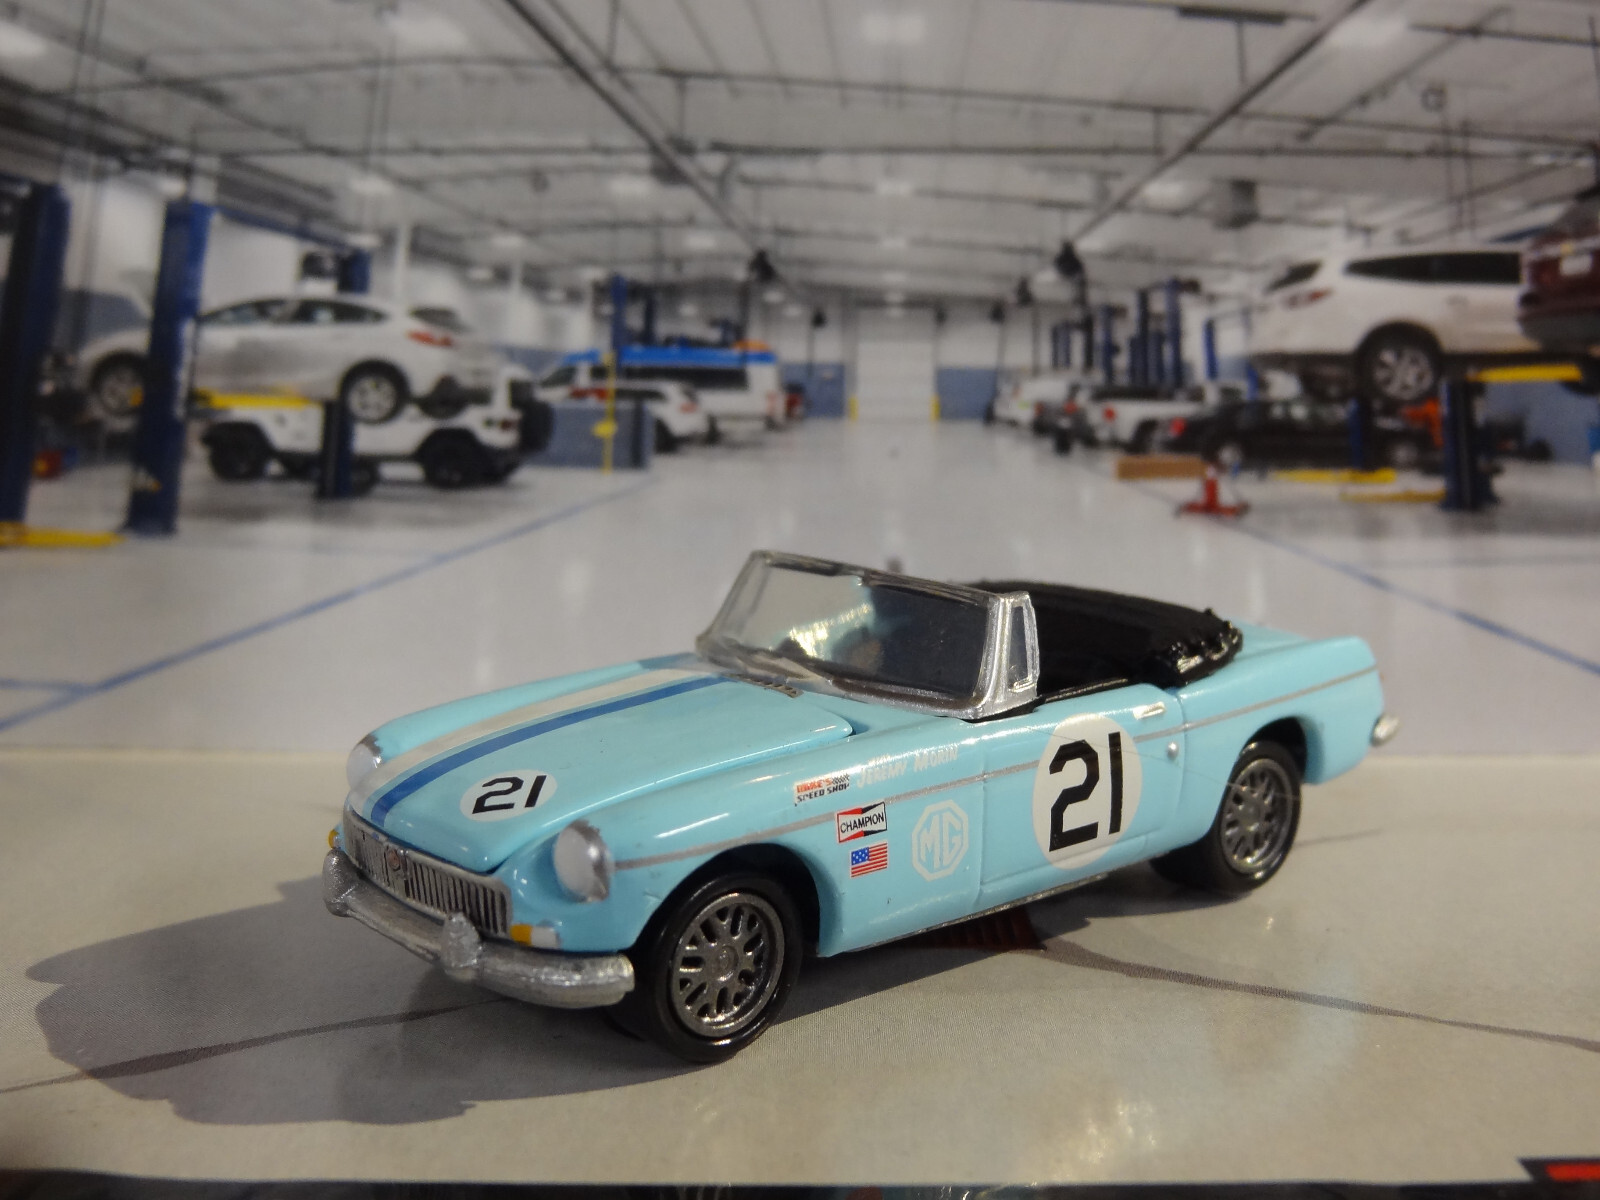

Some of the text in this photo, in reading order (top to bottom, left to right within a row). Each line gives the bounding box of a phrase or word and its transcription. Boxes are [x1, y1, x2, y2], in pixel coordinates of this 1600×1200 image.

[471, 774, 547, 815] 21
[797, 783, 850, 802] SPEED SHOP
[1048, 731, 1124, 853] 21
[840, 811, 885, 834] CHAMPION
[920, 811, 962, 869] MG
